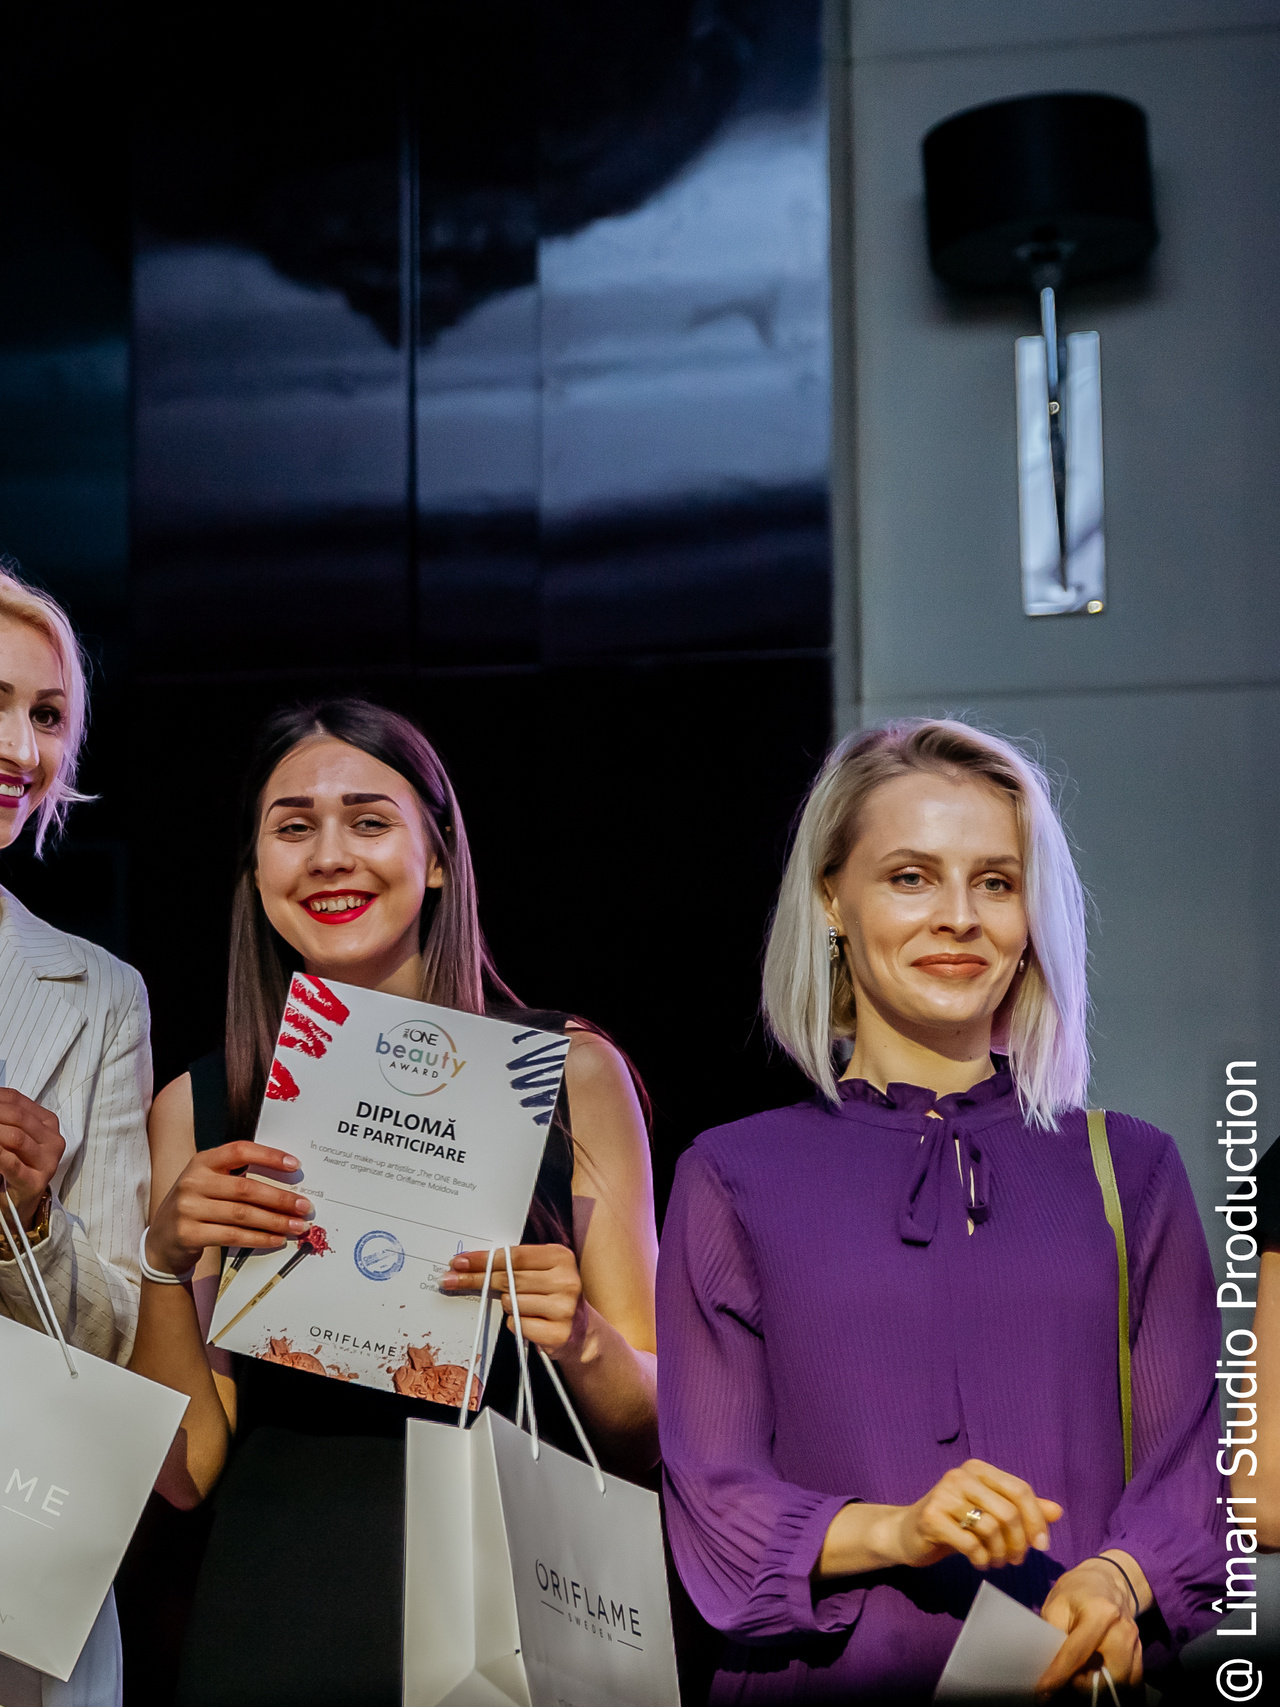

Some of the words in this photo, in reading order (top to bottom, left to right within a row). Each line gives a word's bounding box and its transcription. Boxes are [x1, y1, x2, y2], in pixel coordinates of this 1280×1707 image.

[375, 1032, 467, 1078] beauty
[409, 1028, 439, 1046] ONE
[389, 1061, 439, 1078] AWARD
[355, 1101, 457, 1141] DIPLOMĂ
[337, 1120, 360, 1137] DE
[363, 1127, 467, 1163] PARTICIPARE
[318, 1144, 353, 1159] concursul
[354, 1152, 386, 1168] make-up
[434, 1173, 451, 1184] ONE
[452, 1177, 477, 1191] Beauty
[350, 1162, 383, 1178] organizat
[384, 1169, 395, 1180] de
[395, 1173, 426, 1188] Oriflame
[427, 1182, 459, 1196] Moldova
[309, 1325, 397, 1357] ORIFLAME
[535, 1558, 642, 1637] ORIFLAME
[568, 1612, 613, 1642] SWEDEN
